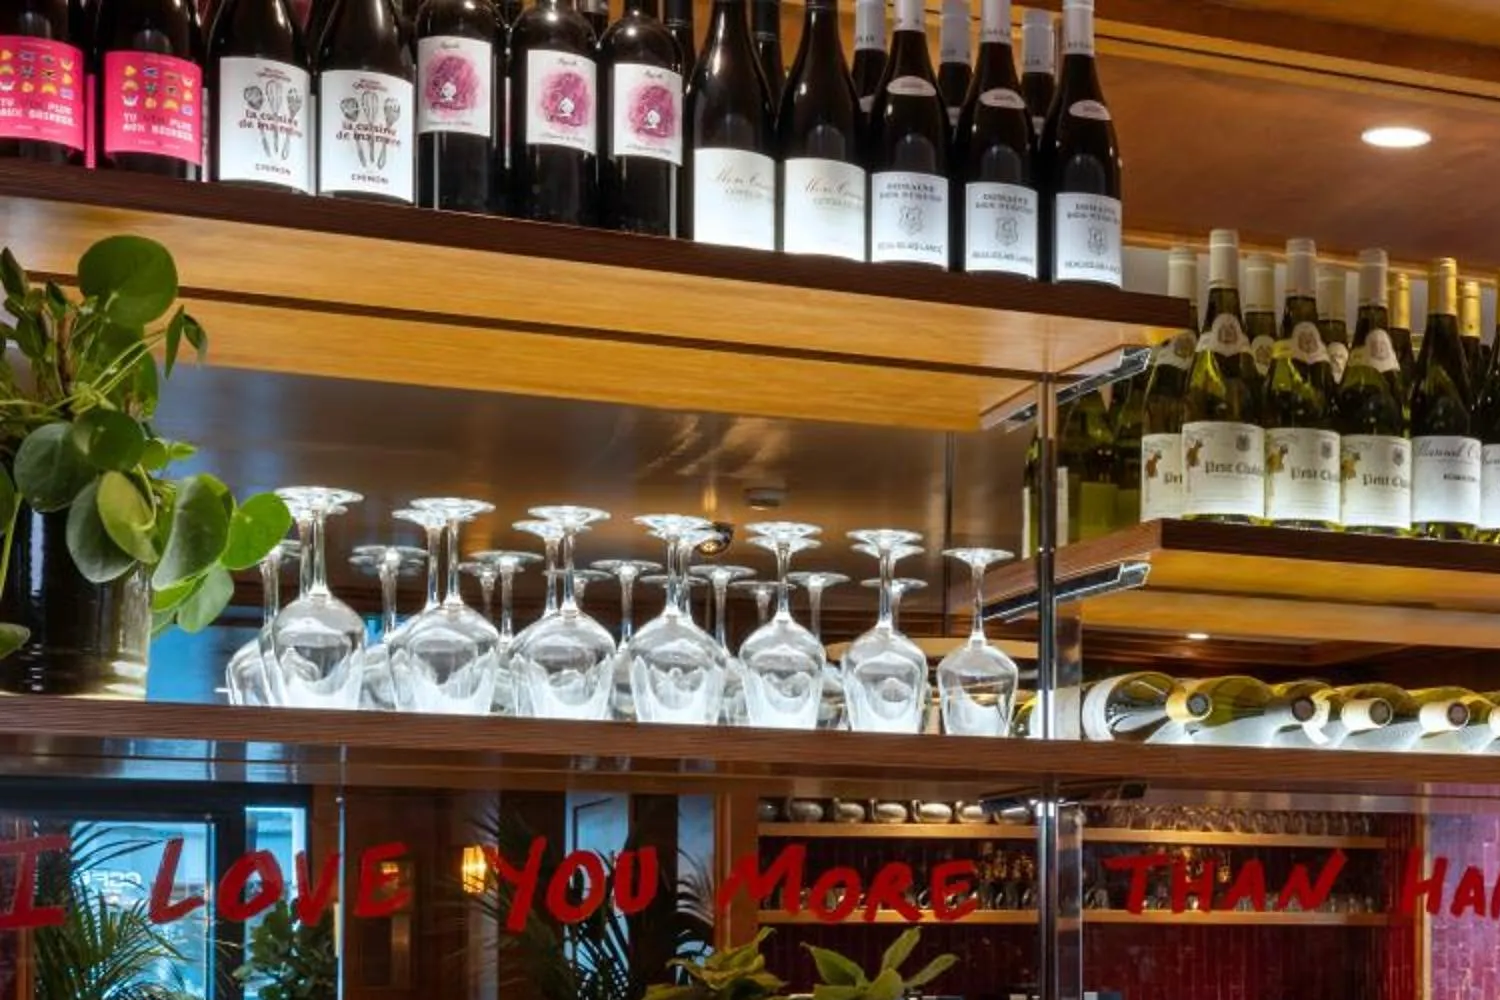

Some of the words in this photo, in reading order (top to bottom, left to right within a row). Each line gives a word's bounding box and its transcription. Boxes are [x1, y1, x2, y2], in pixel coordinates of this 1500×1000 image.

[0, 834, 70, 929] I
[149, 836, 411, 926] LOVE
[498, 836, 658, 932] YOU
[715, 844, 978, 924] MORE
[1104, 848, 1347, 916] THAN
